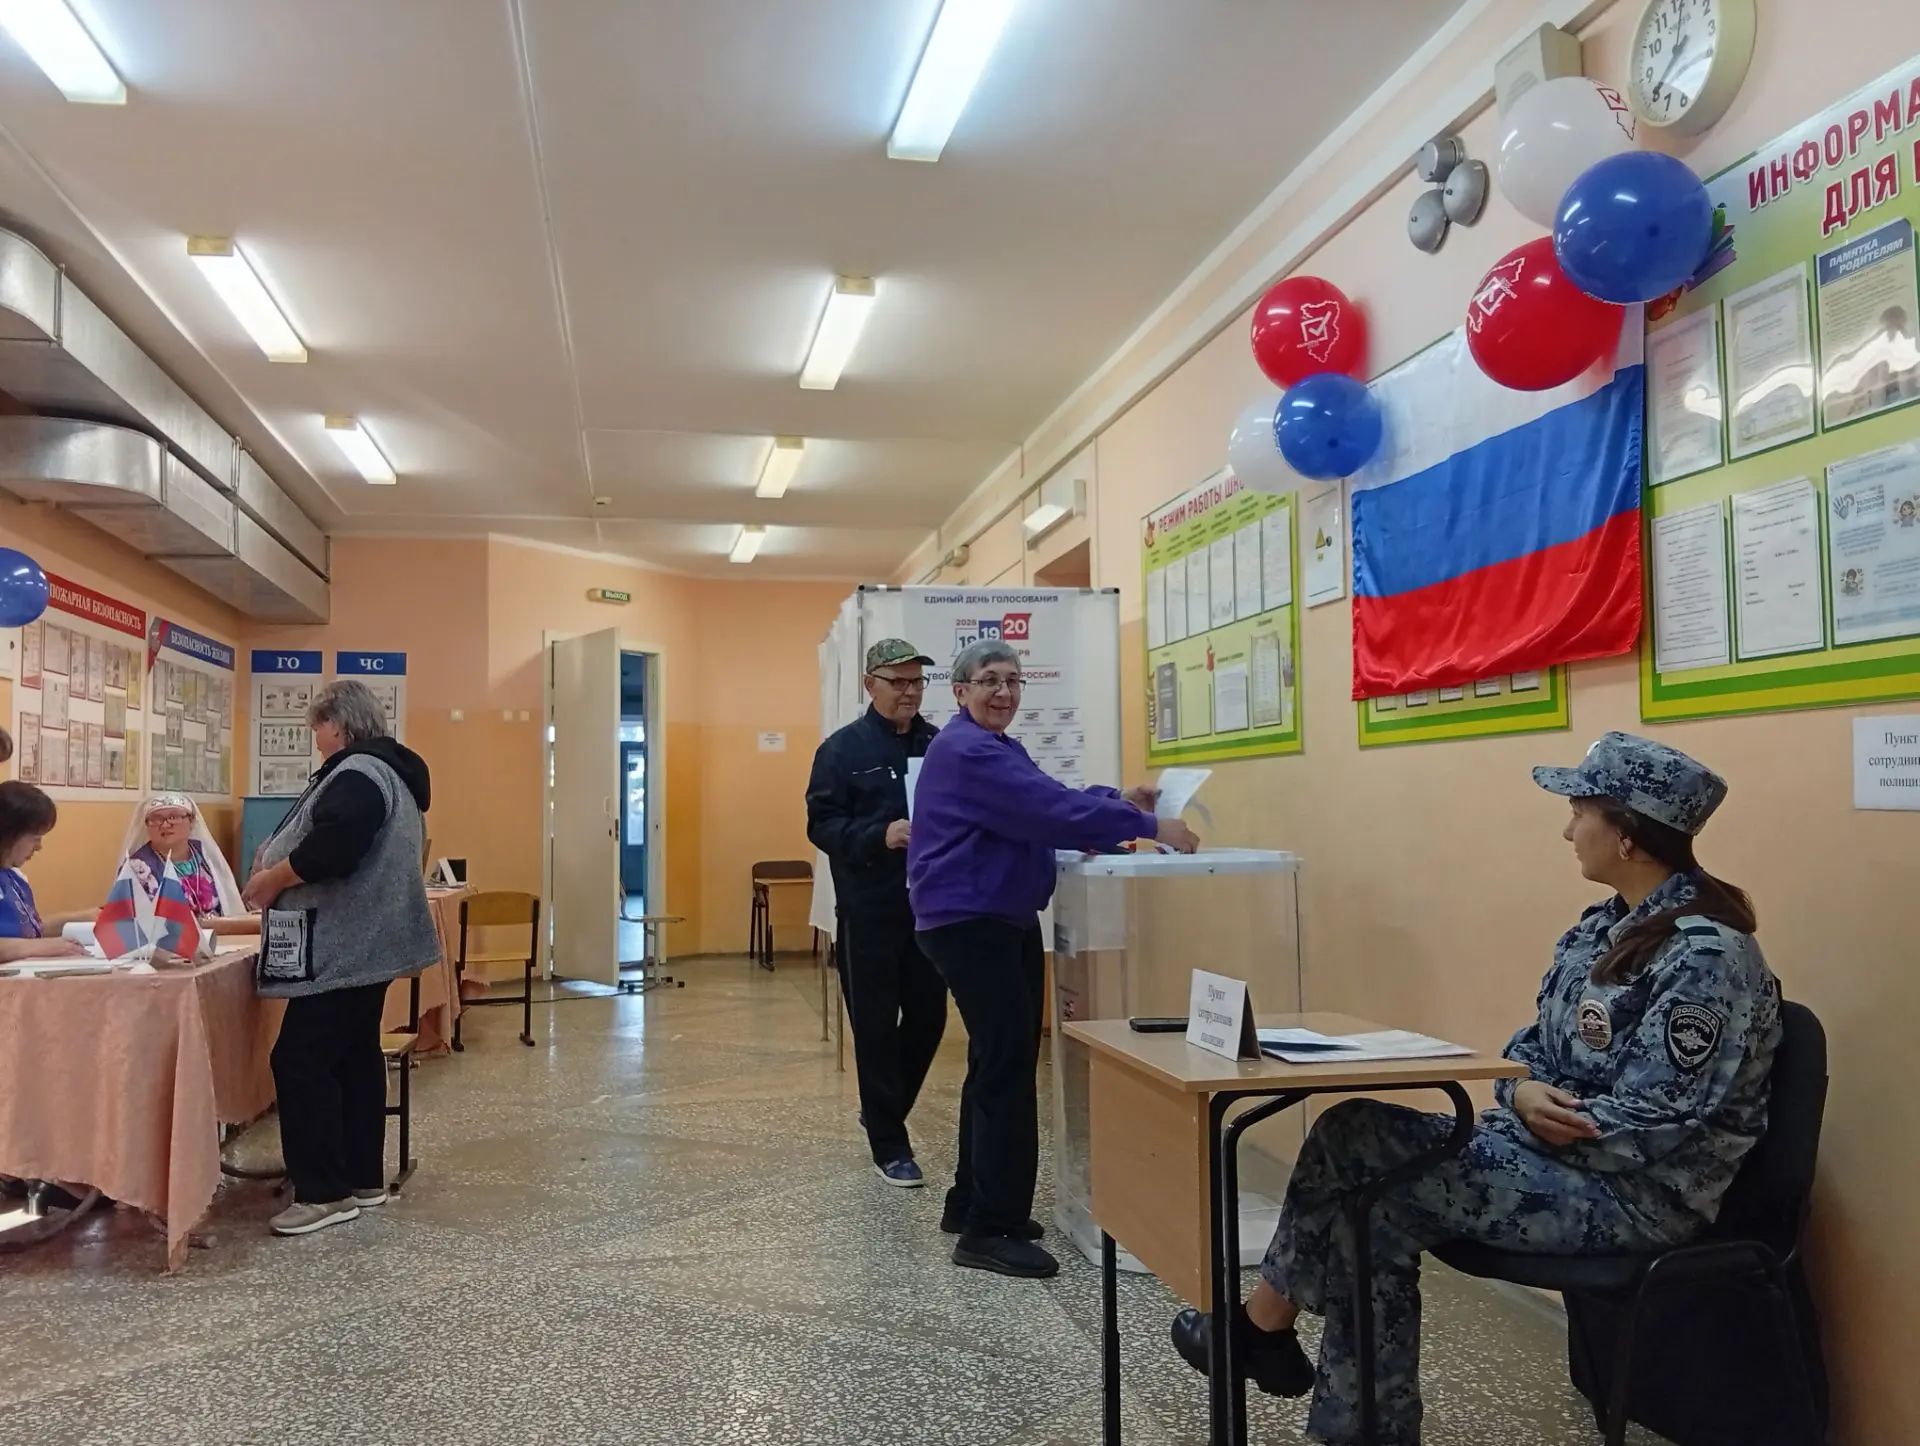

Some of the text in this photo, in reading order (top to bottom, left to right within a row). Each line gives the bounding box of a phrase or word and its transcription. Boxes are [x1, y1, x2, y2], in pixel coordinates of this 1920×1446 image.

[1702, 0, 1711, 16] 2
[1655, 12, 1668, 34] 11
[1708, 19, 1716, 36] 3
[1648, 38, 1662, 58] 10
[1646, 66, 1654, 84] 9
[1748, 76, 1920, 210] ИНФОРМА
[1823, 153, 1898, 236] ДЛЯ
[1829, 238, 1879, 268] ПАМЯТКА
[1839, 237, 1904, 274] РОДИТЕЛЯМ
[1187, 483, 1222, 519] РАБОТЫ
[49, 583, 142, 631] ПОЖАРНАЯ БЕЗОПАСНОСТЬ
[924, 594, 1059, 605] ЕДИНЫЙ ДЕНЬ ГОЛОСОВАНИЯ
[980, 626, 1000, 640] 19
[1004, 618, 1027, 635] 20
[276, 656, 300, 669] ГО
[359, 658, 384, 671] ЧС
[926, 669, 951, 681] ТВОЙ
[1884, 732, 1919, 748] Пункт
[1868, 755, 1920, 769] сотрудни
[1879, 777, 1920, 788] полици
[1673, 1007, 1717, 1028] ПОЛИЦИЯ
[1676, 1017, 1710, 1035] РОССИЯ
